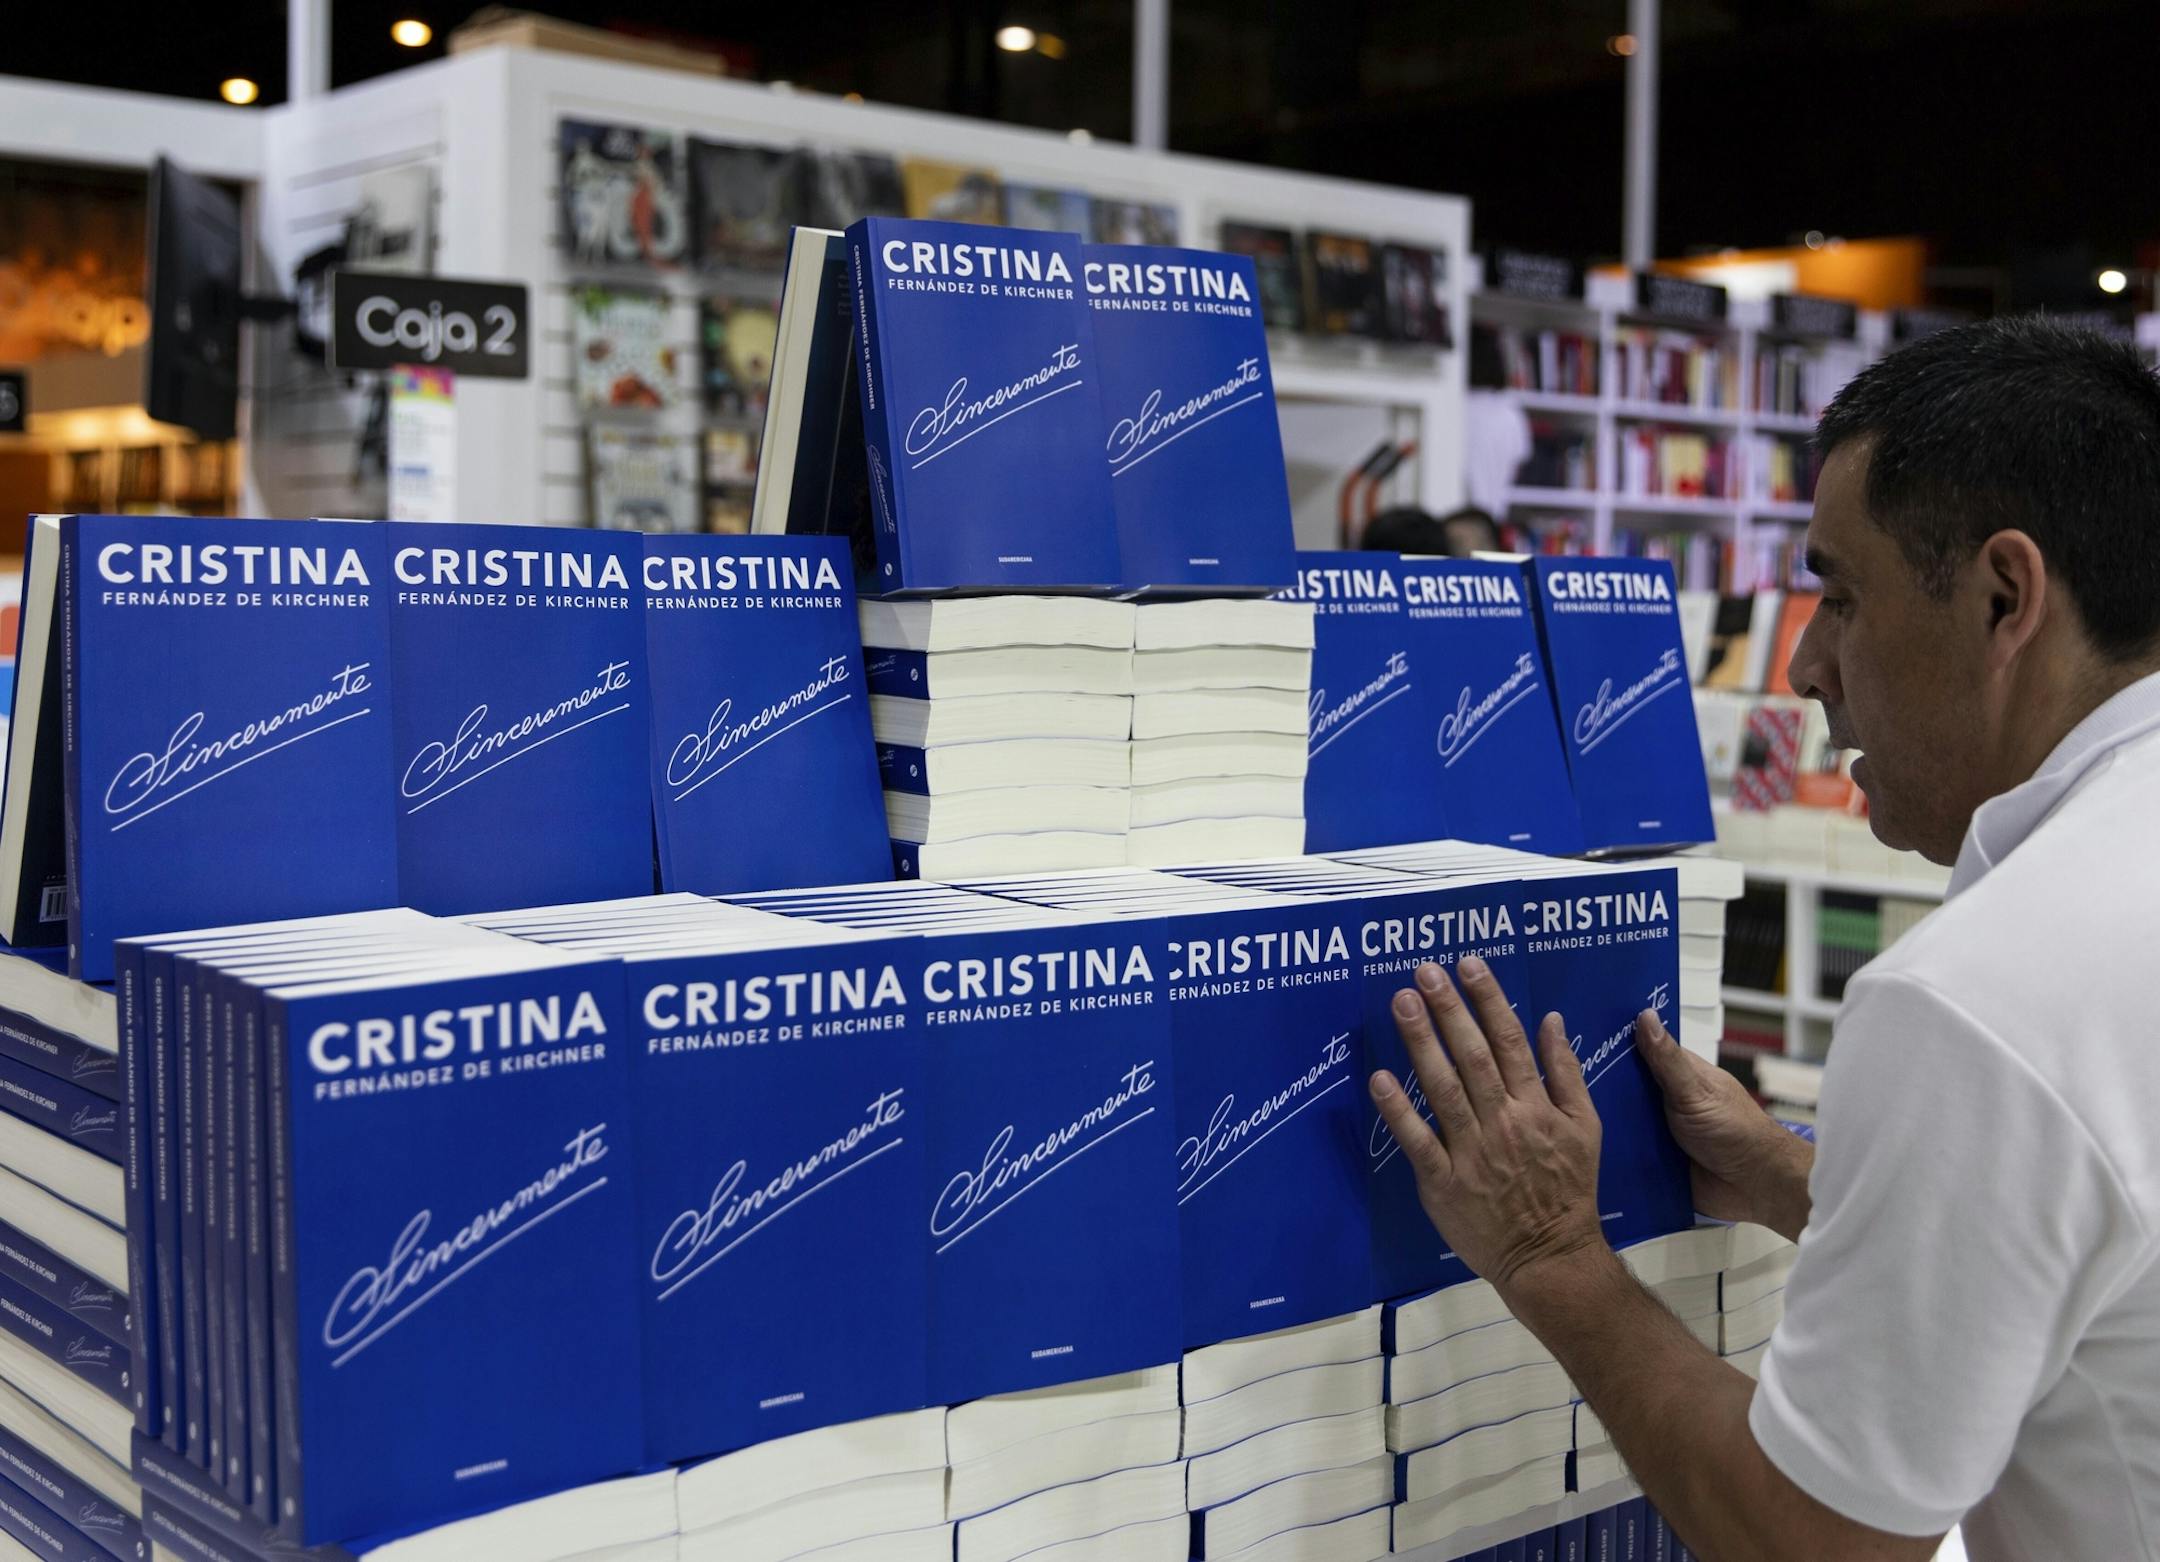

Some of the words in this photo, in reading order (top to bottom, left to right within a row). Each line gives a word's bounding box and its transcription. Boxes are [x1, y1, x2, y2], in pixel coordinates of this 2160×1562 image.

[854, 245, 862, 288] CRISTINA
[883, 240, 1073, 282] CRISTINA
[889, 279, 974, 293] FERNÁNDEZ
[981, 284, 998, 295] DE
[1005, 286, 1073, 299] KIRCHNER
[1084, 263, 1250, 301] CRISTINA
[1173, 301, 1189, 312] DE
[1195, 303, 1251, 316] KIRCHNER
[355, 296, 476, 360] Caja
[484, 305, 516, 355] 2
[864, 345, 870, 360] DE
[865, 361, 875, 410] KIRCHNER
[98, 543, 370, 585] CRISTINA
[395, 548, 629, 589] CRISTINA
[643, 556, 841, 590] CRISTINA
[103, 590, 226, 605] FERNÁNDEZ
[237, 593, 261, 605] DE
[273, 594, 368, 606] KIRCHNER
[399, 591, 506, 605] FERNÁNDEZ
[516, 595, 536, 606] DE
[546, 596, 628, 608] KIRCHNER
[647, 595, 738, 609] FERNÁNDEZ
[745, 597, 763, 608] DE
[771, 597, 841, 608] KIRCHNER
[1403, 576, 1521, 604] CRISTINA
[1548, 571, 1671, 600] CRISTINA
[1329, 603, 1343, 613] DE
[1347, 603, 1399, 613] KIRCHNER
[1409, 606, 1464, 619] FERNÁNDEZ
[1467, 607, 1478, 618] DE
[1480, 607, 1522, 618] KIRCHNER
[1523, 890, 1669, 935] CRISTINA
[1361, 904, 1515, 957] CRISTINA
[1528, 934, 1592, 953] ERNÁNDEZ
[1597, 934, 1612, 945] DE
[1616, 927, 1669, 943] KIRCHNER
[1439, 952, 1454, 965] DE
[924, 946, 1154, 1006] CRISTINA
[1170, 981, 1249, 1000] ERNÁNDEZ
[1257, 978, 1274, 990] DE
[1282, 969, 1348, 987] KIRCHNER
[644, 966, 906, 1035] CRISTINA
[927, 1003, 1032, 1025] FERNÁNDEZ
[1041, 1000, 1061, 1014] DE
[1070, 991, 1152, 1011] KIRCHNER
[309, 992, 606, 1076] CRISTINA
[649, 1028, 769, 1053] FERNÁNDEZ
[779, 1025, 802, 1041] DE
[812, 1015, 904, 1036] KIRCHNER
[316, 1066, 452, 1098] FERNÁNDEZ
[462, 1055, 491, 1078] DE
[501, 1044, 605, 1072] KIRCHNER
